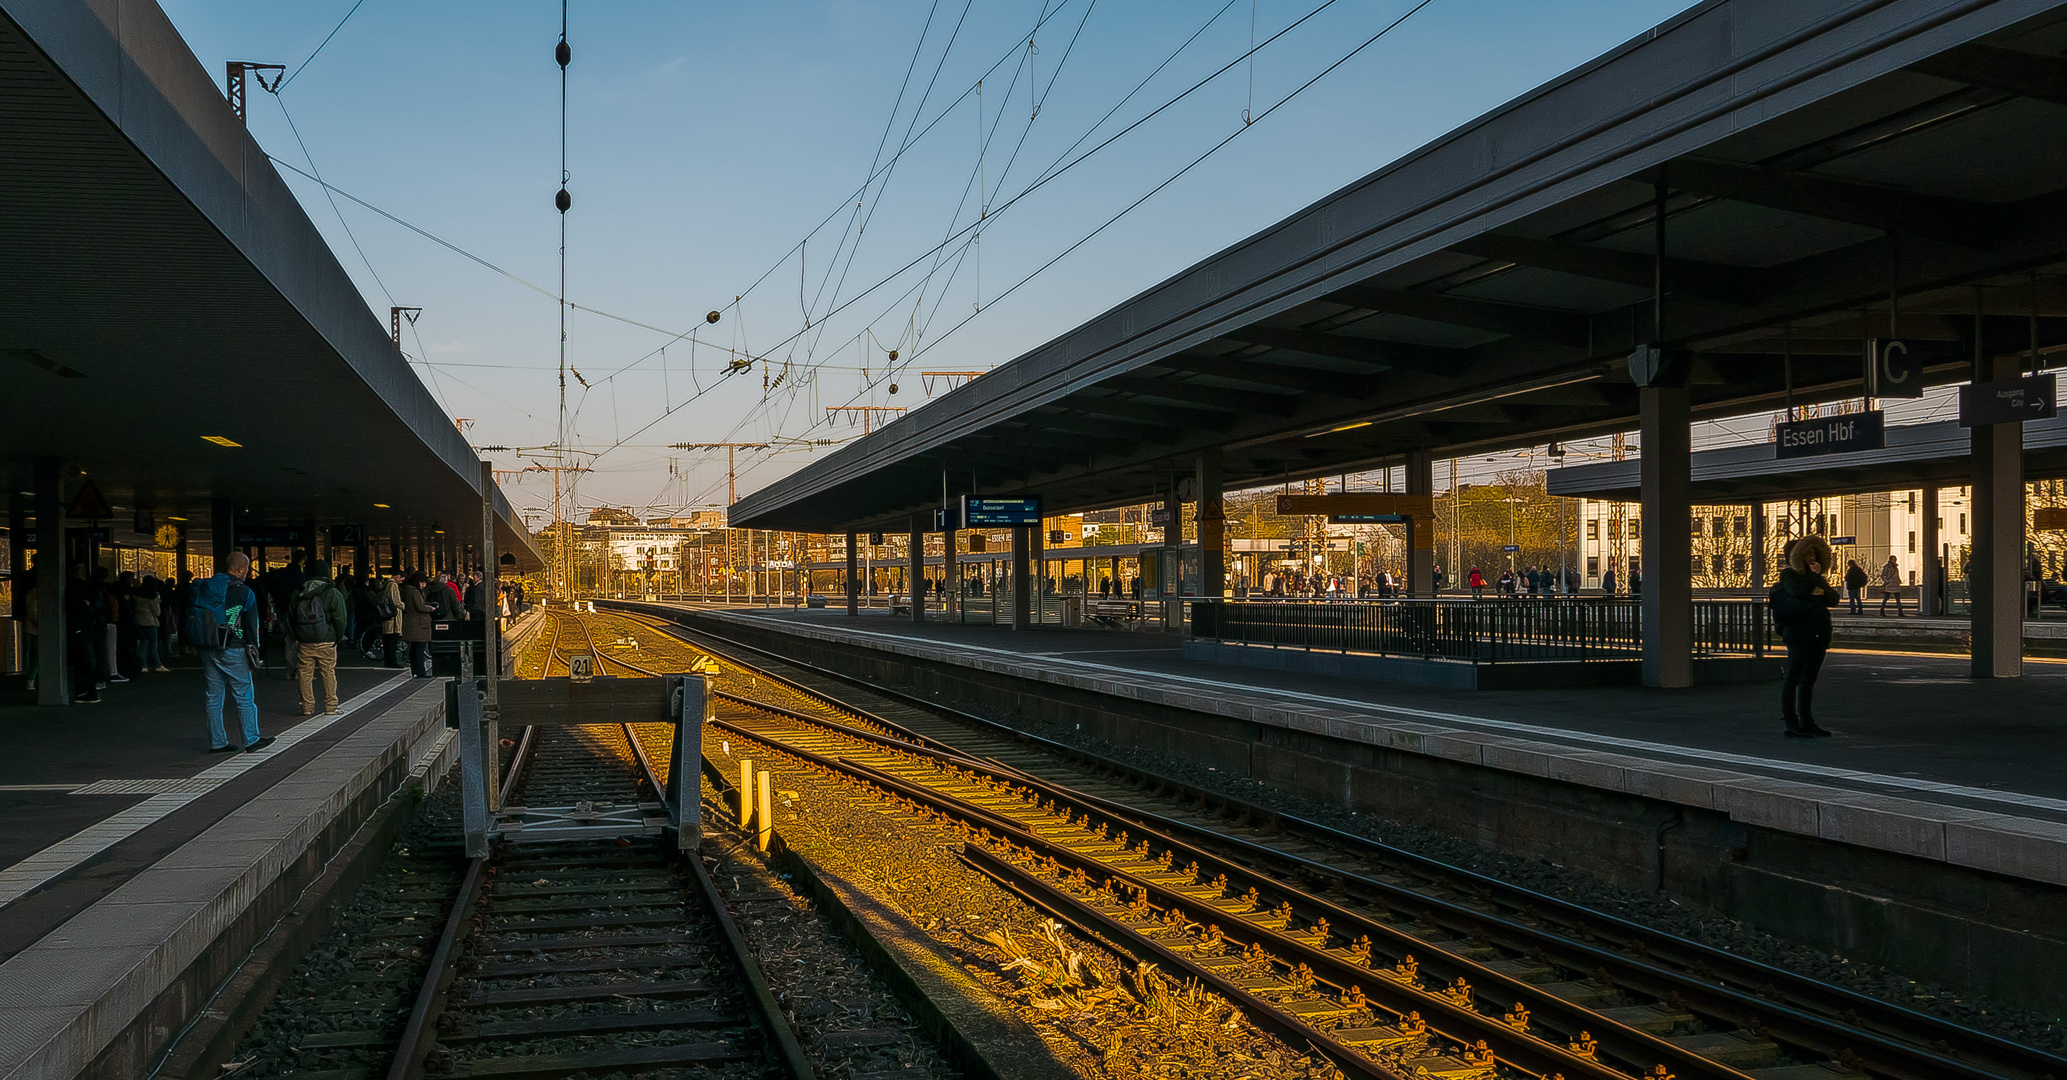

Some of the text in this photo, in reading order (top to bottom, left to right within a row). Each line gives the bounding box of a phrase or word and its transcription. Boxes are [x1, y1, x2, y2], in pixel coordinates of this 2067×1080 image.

[1883, 340, 1909, 384] C
[1996, 389, 2025, 399] Ausgang
[2011, 399, 2024, 408] City
[1783, 420, 1855, 448] Essen Hbf
[937, 510, 945, 527] 1
[26, 533, 37, 543] 22
[288, 531, 299, 540] 21
[343, 525, 362, 542] 21
[871, 532, 879, 543] B
[1055, 531, 1063, 541] B
[573, 659, 588, 675] 21
